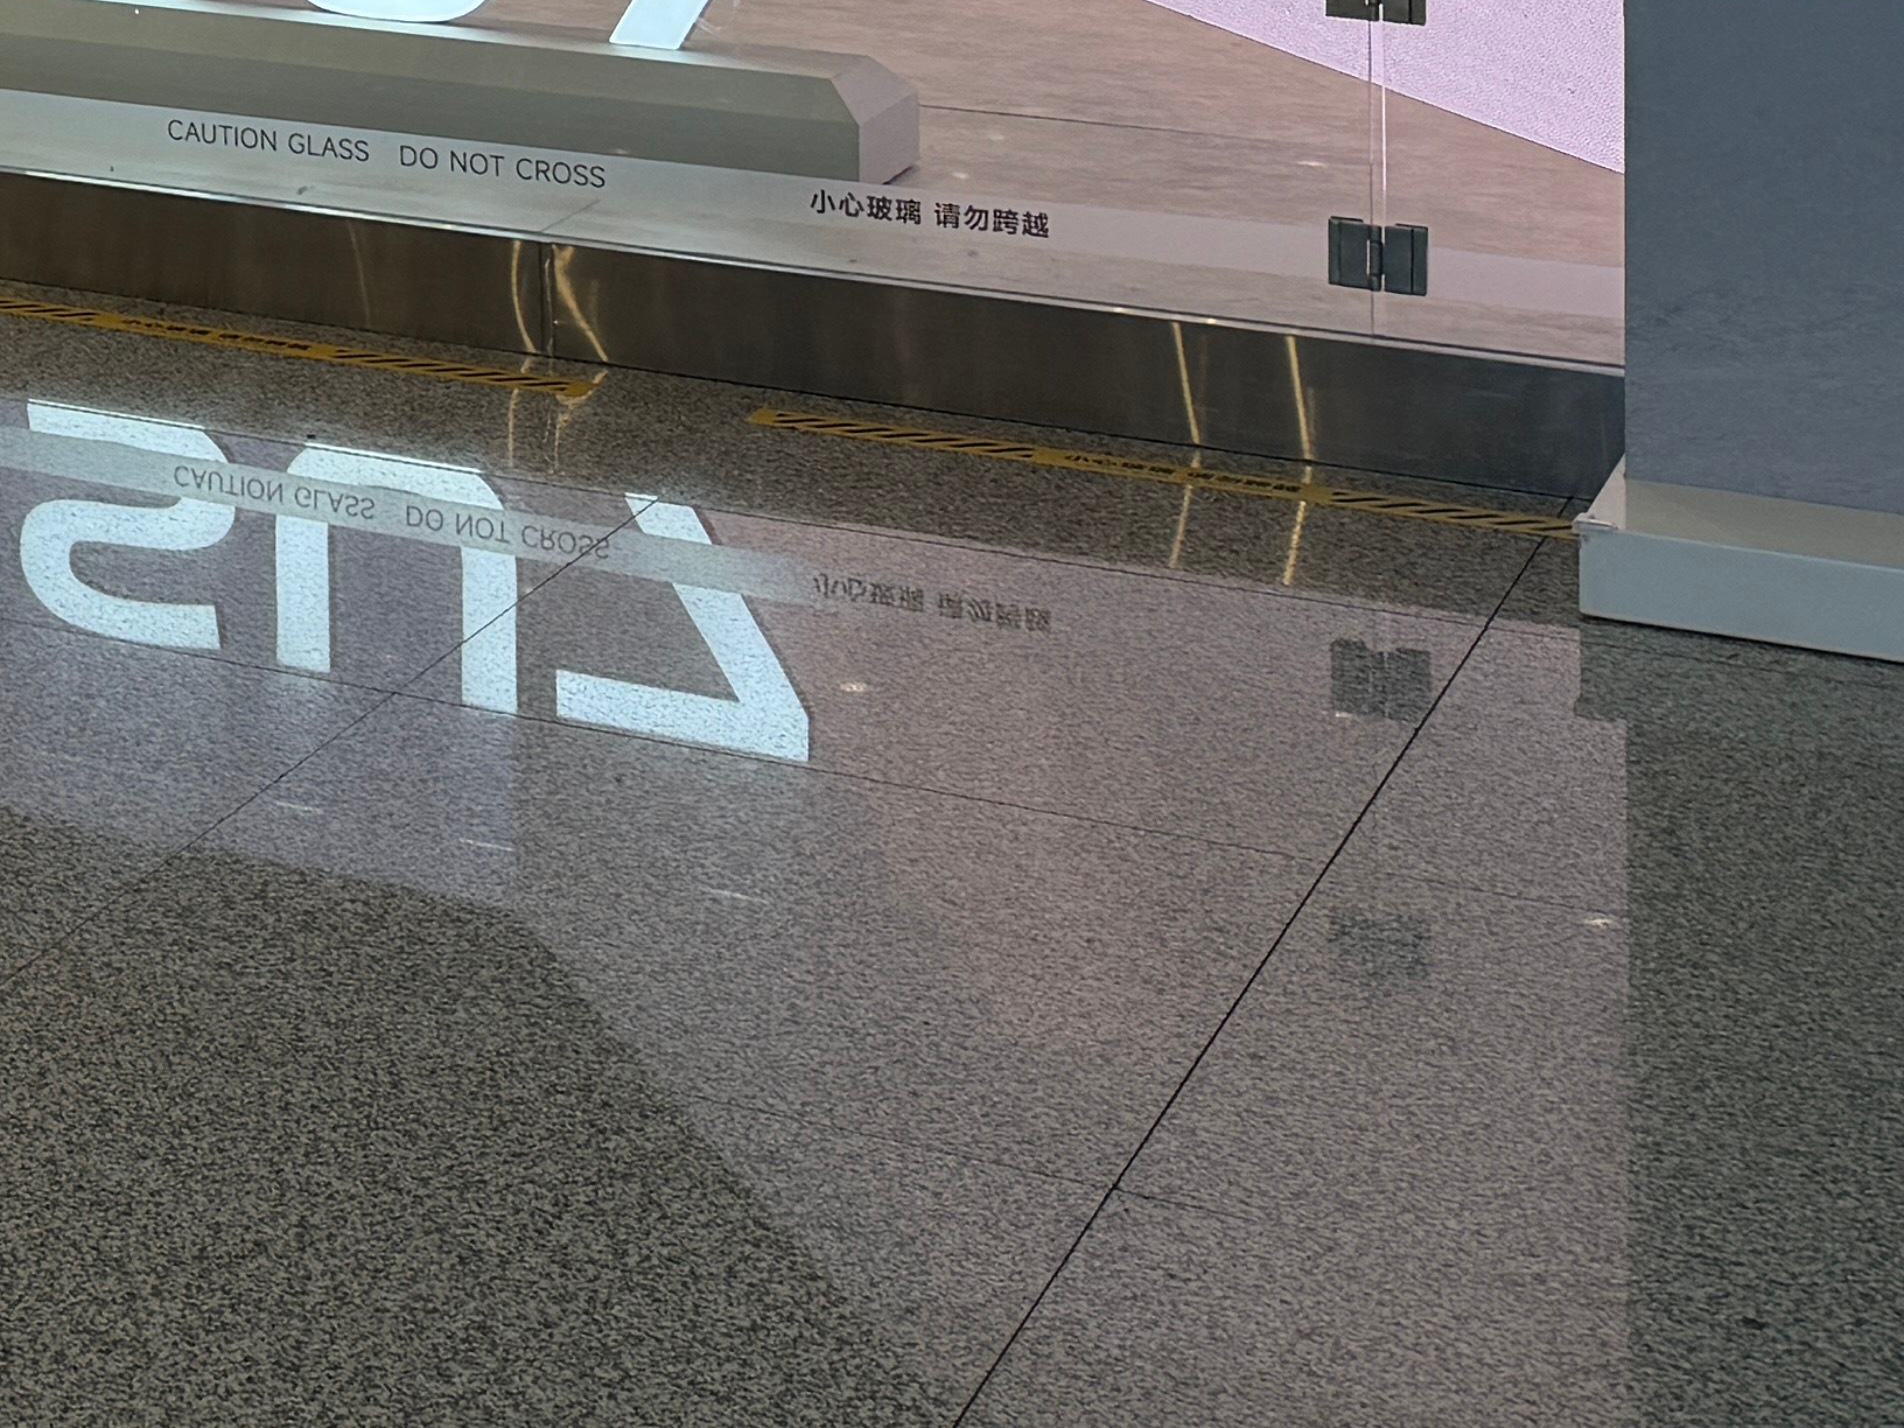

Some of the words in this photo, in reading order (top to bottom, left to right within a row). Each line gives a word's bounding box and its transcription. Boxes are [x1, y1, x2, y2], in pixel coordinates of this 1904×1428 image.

[167, 117, 278, 152] CAUTION
[287, 132, 370, 163] GLASS
[398, 144, 438, 172] DO
[449, 150, 505, 180] NOT
[515, 156, 607, 191] CROSS
[809, 187, 923, 229] 小心玻璃
[933, 199, 1051, 240] 请勿跨越
